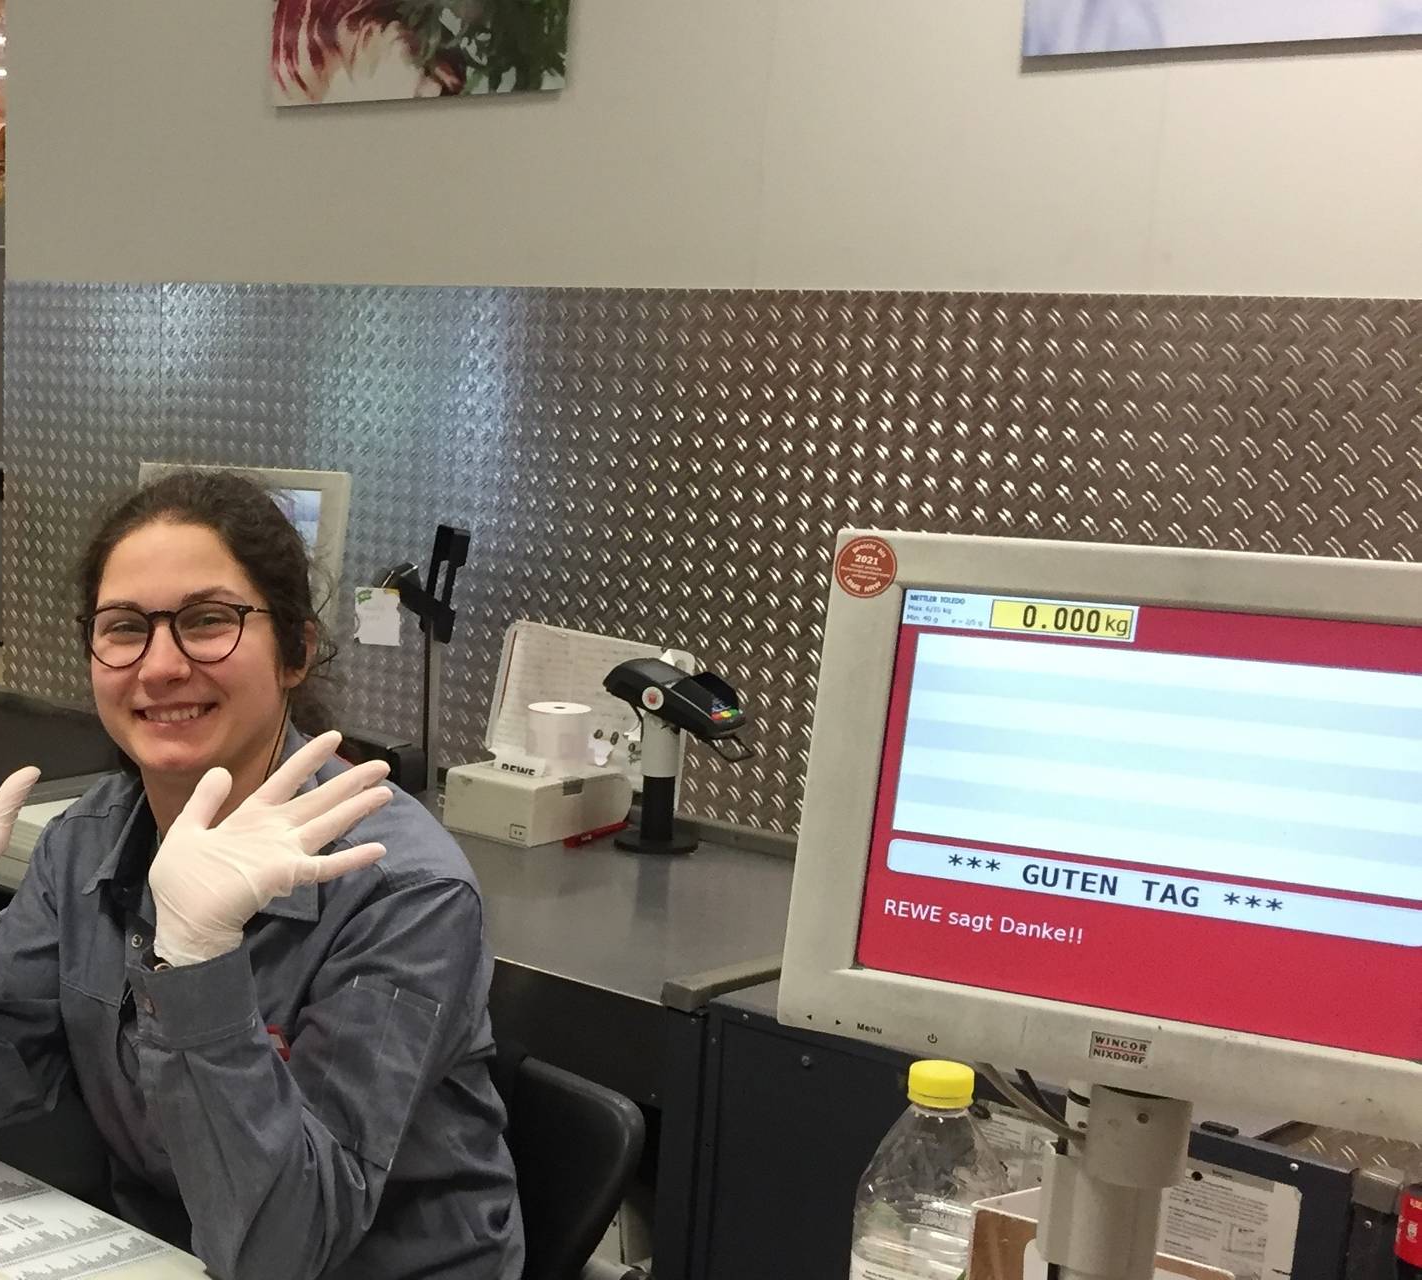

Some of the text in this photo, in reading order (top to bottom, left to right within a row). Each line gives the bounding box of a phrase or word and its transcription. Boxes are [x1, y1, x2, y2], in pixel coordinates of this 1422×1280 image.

[855, 554, 878, 566] 2021
[910, 594, 965, 605] METTLER TOLEDO
[1022, 604, 1128, 636] 0.000 kg
[1022, 863, 1118, 896] GUTEN
[1141, 879, 1200, 908] TAG
[884, 899, 1083, 945] REWE sagt Danke!!
[856, 1022, 882, 1035] Menu
[1095, 1036, 1148, 1052] WINCOR
[1093, 1048, 1146, 1064] NIXDORF
